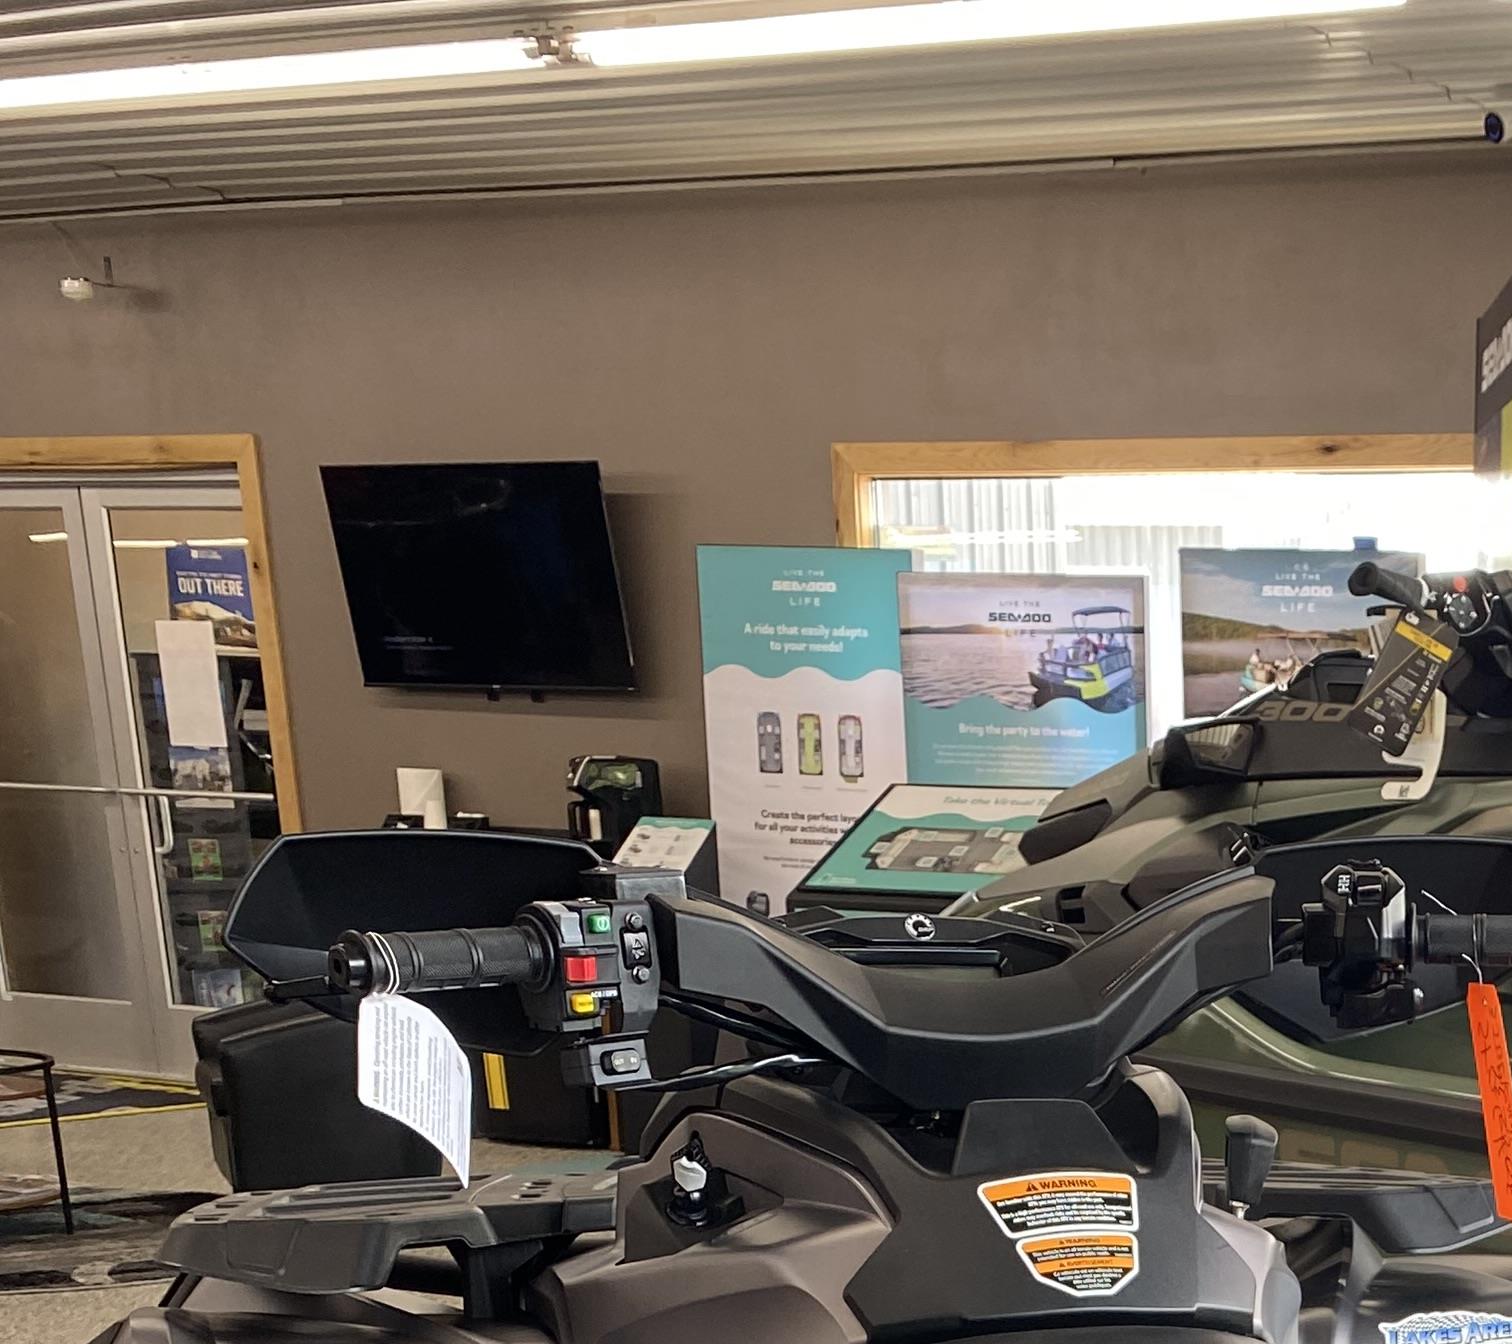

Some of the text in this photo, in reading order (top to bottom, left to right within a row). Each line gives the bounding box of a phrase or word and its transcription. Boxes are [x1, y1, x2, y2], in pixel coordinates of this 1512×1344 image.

[178, 577, 244, 596] OUT THERE
[790, 597, 821, 606] LIFE
[1280, 602, 1315, 613] LIFE
[754, 623, 774, 635] ride
[777, 624, 800, 635] that
[801, 624, 831, 639] easily
[832, 626, 869, 640] adapts
[1004, 629, 1037, 638] LIFE
[770, 640, 781, 651] to
[784, 642, 807, 654] your
[1257, 700, 1350, 722] 300
[959, 723, 984, 736] Bring
[986, 724, 1001, 734] the
[1003, 725, 1028, 738] party
[1030, 726, 1040, 735] to
[761, 809, 789, 820] Create
[791, 811, 805, 820] the
[807, 811, 838, 823] perfect
[754, 822, 768, 830] for
[769, 822, 778, 832] all
[780, 825, 798, 833] your
[800, 824, 838, 834] activities
[1039, 1179, 1097, 1190] WARNING
